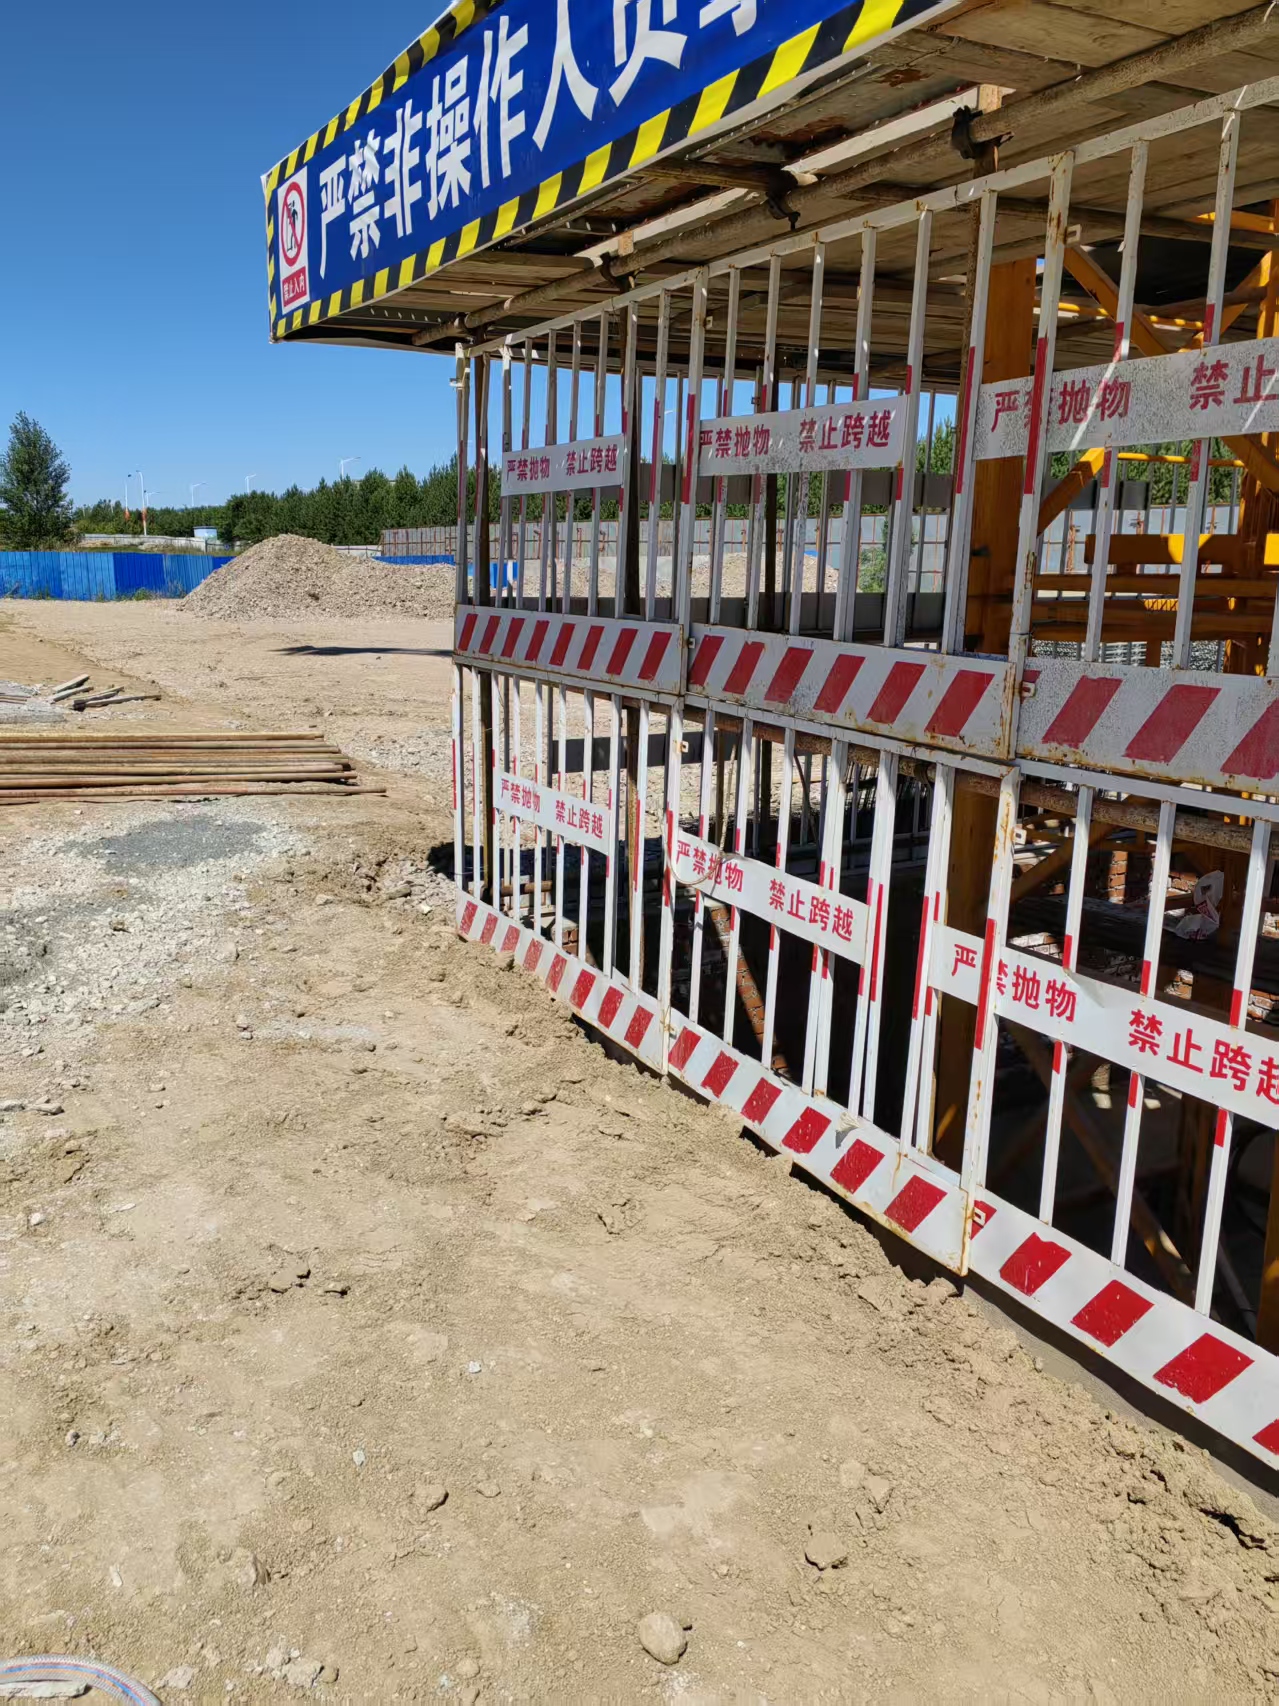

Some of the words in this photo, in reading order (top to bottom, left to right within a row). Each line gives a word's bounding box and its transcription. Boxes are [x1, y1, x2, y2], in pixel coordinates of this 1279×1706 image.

[319, 0, 757, 279] 严禁非操作人员
[283, 274, 305, 301] 禁止入内
[506, 454, 551, 481] 严禁抛物
[565, 443, 618, 476] 禁止跨越
[698, 424, 770, 459] 严禁抛物
[799, 409, 892, 452] 禁止跨越
[500, 778, 541, 814] 严禁抛物
[555, 799, 604, 840] 禁止跨越
[675, 839, 744, 893] 严禁抛物
[768, 878, 854, 943] 禁止跨越
